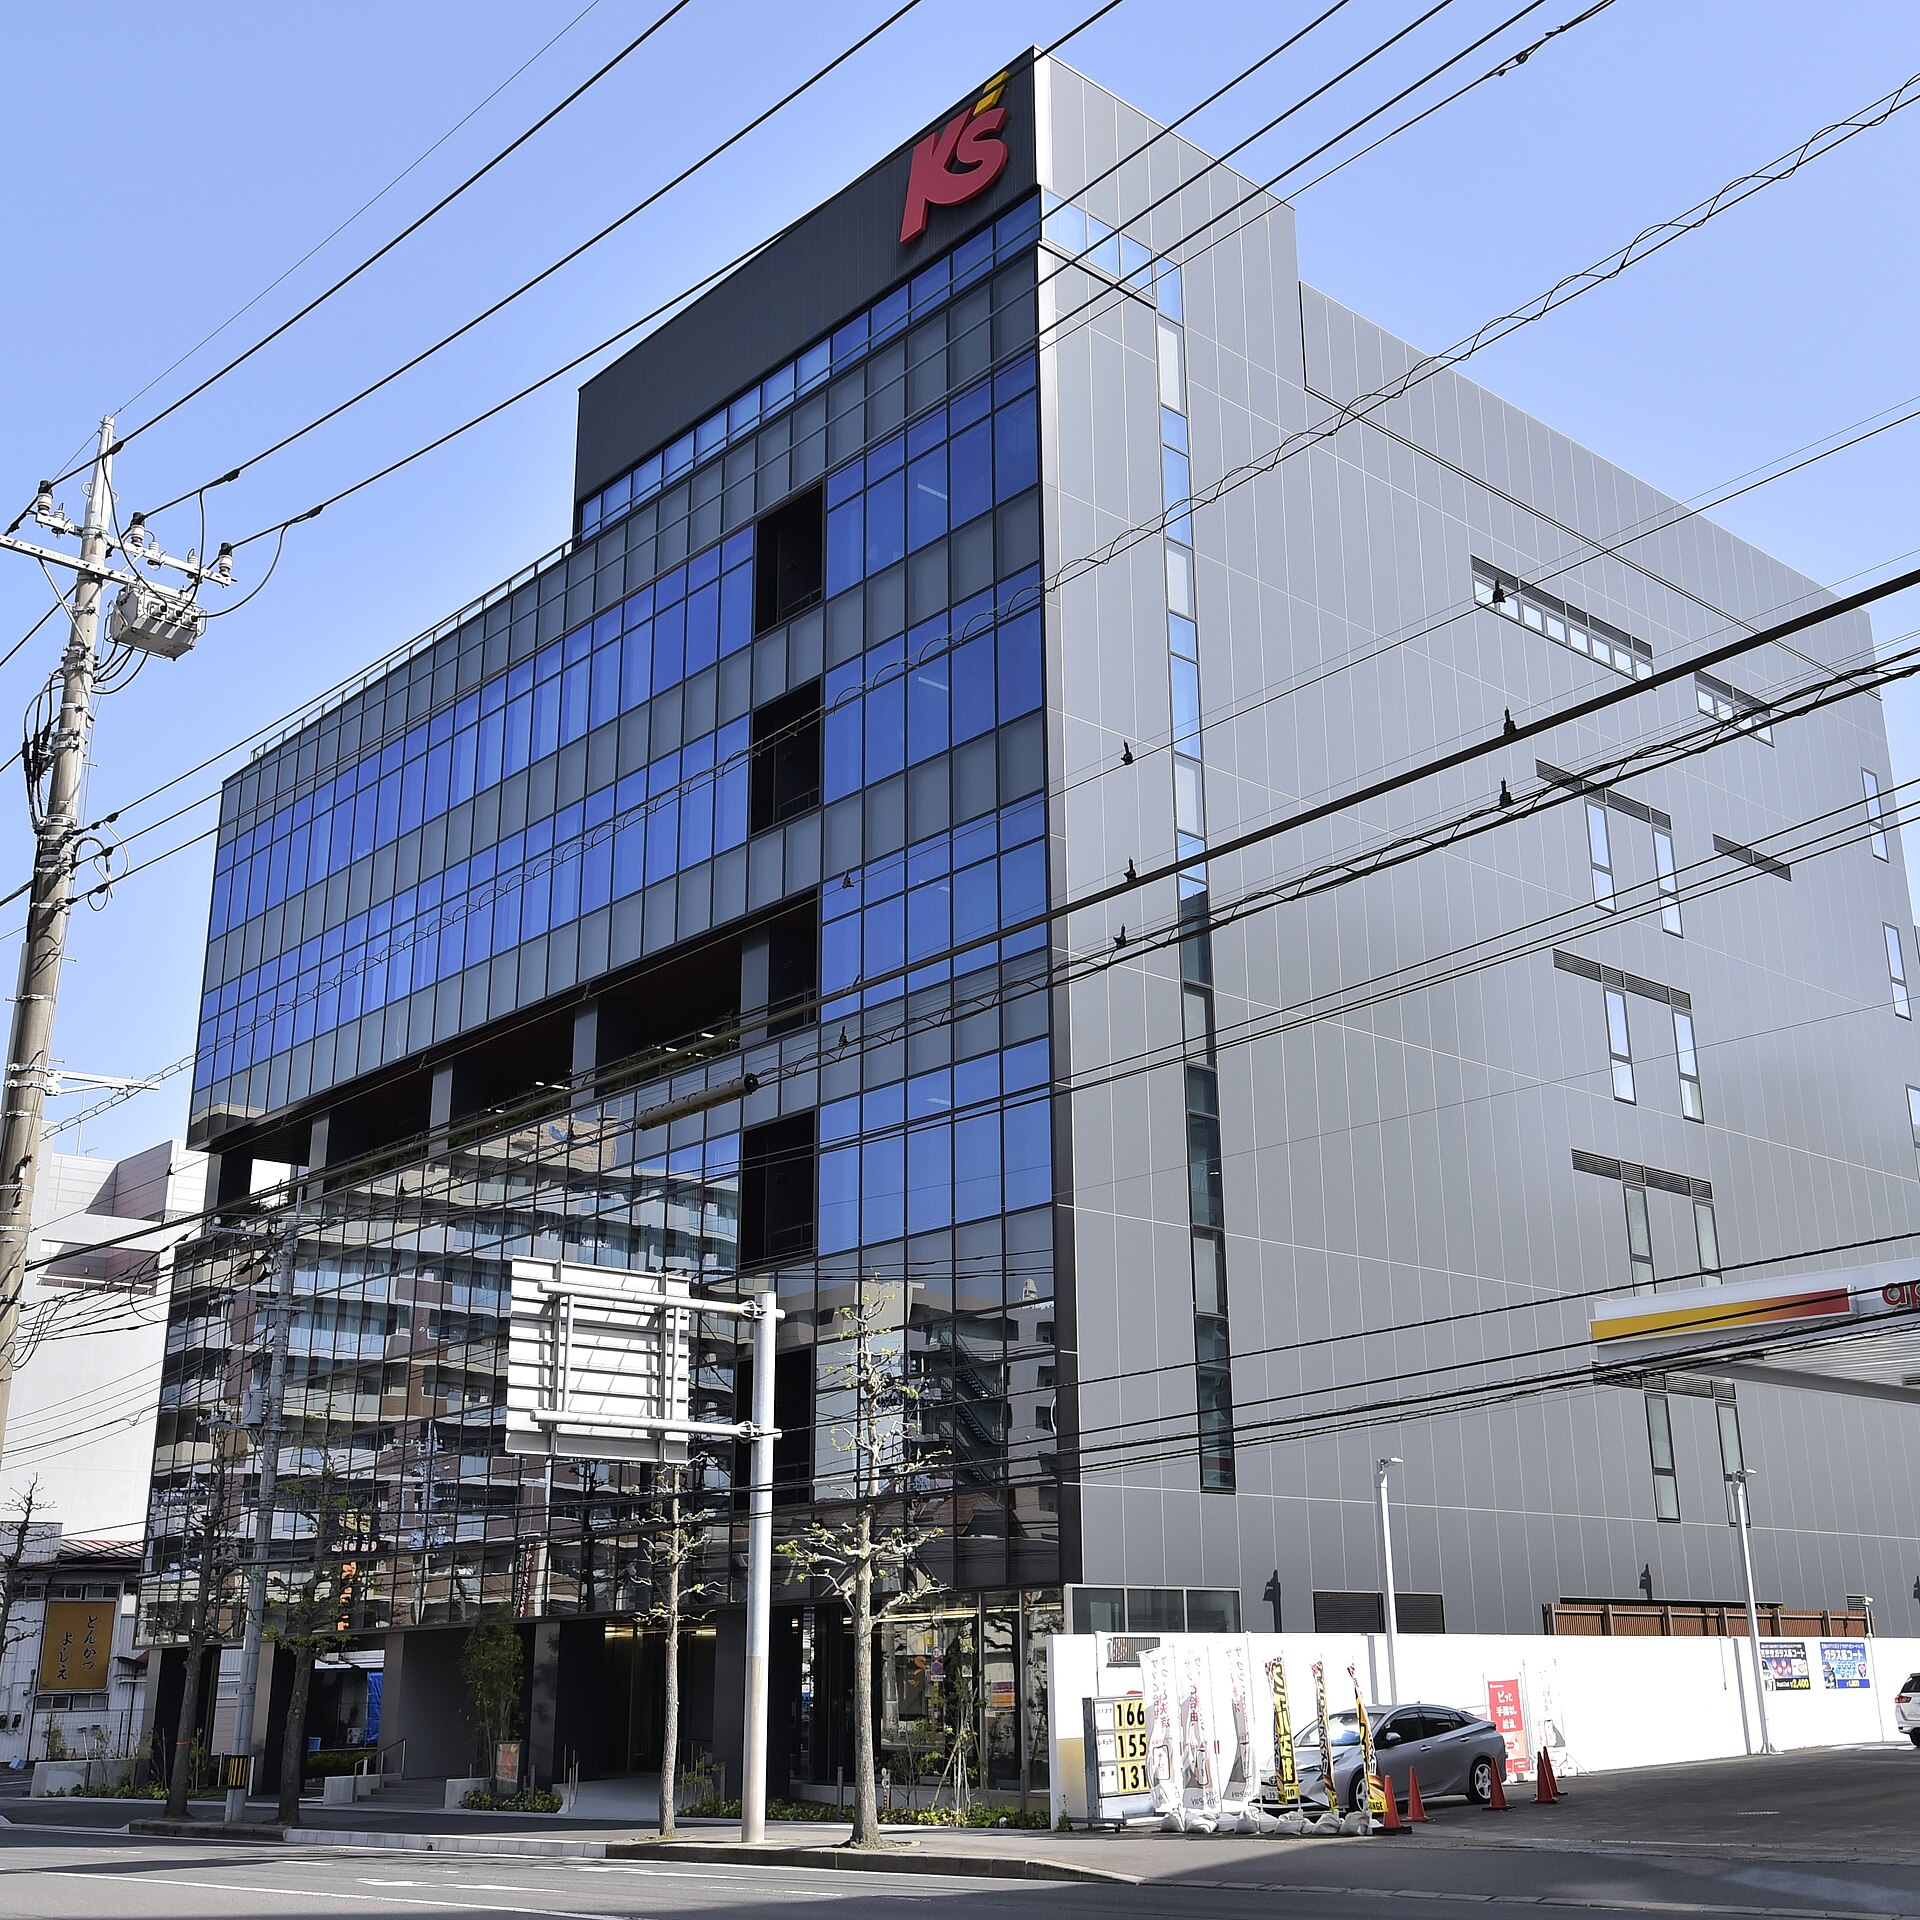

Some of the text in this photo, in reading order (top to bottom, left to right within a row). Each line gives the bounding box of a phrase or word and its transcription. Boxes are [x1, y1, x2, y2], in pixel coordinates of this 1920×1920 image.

[82, 1615, 98, 1670] とんかつ
[1117, 1703, 1145, 1727] 166
[1118, 1733, 1147, 1758] 155
[1121, 1764, 1147, 1790] 131
